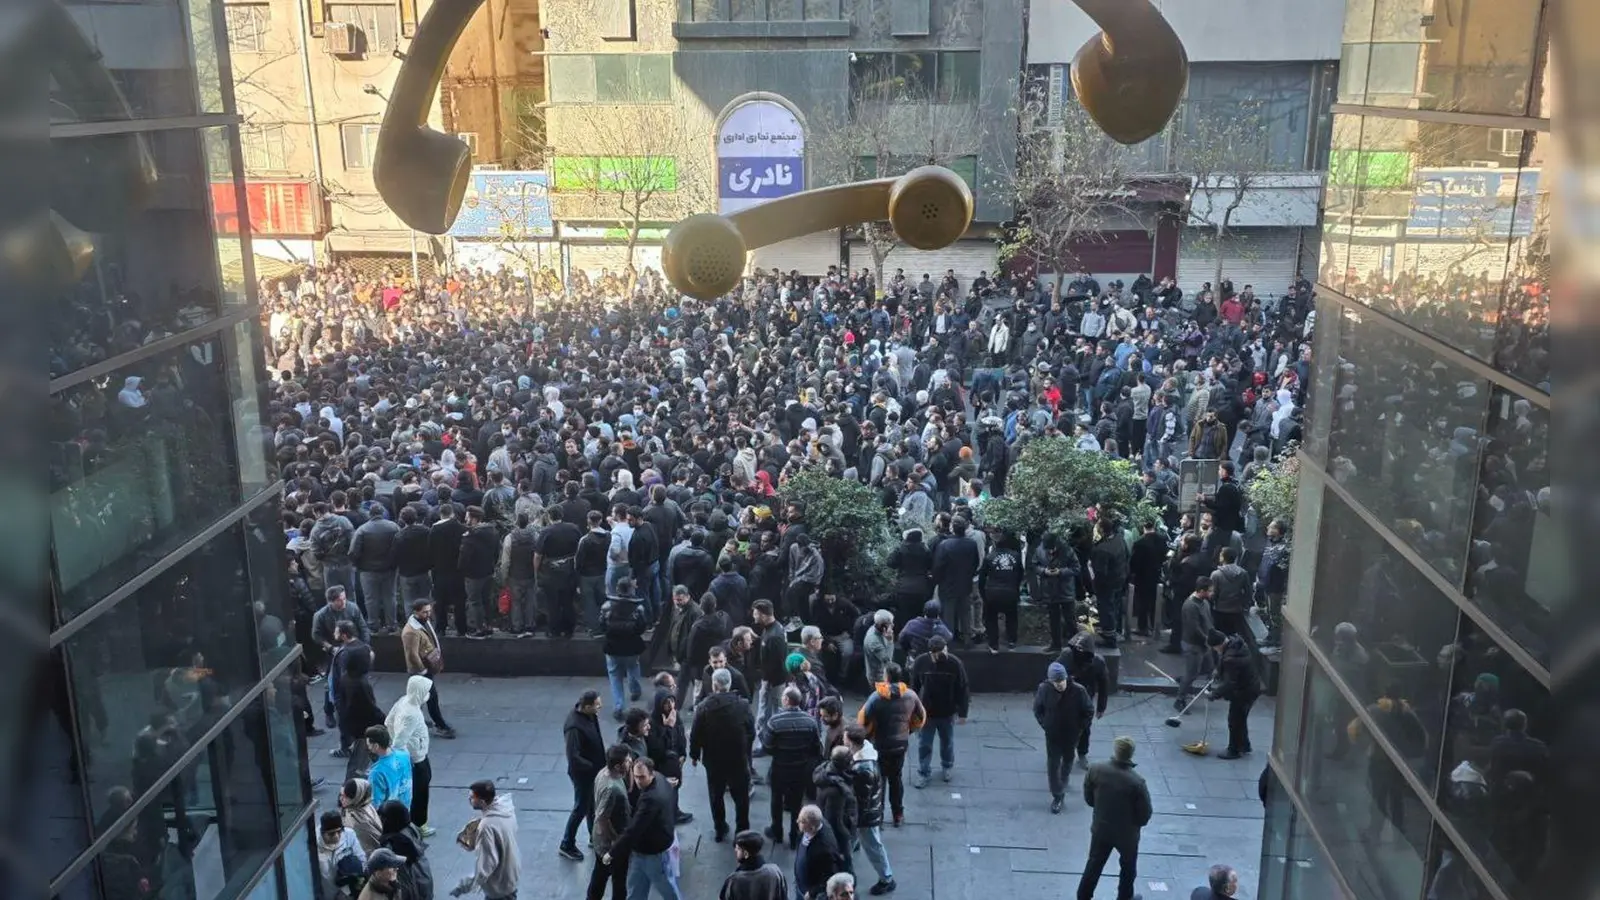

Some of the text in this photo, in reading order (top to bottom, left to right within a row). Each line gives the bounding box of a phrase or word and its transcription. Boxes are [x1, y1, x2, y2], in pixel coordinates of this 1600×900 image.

[723, 131, 797, 144] مجتمع تجاری اداری
[728, 163, 793, 194] نادری
